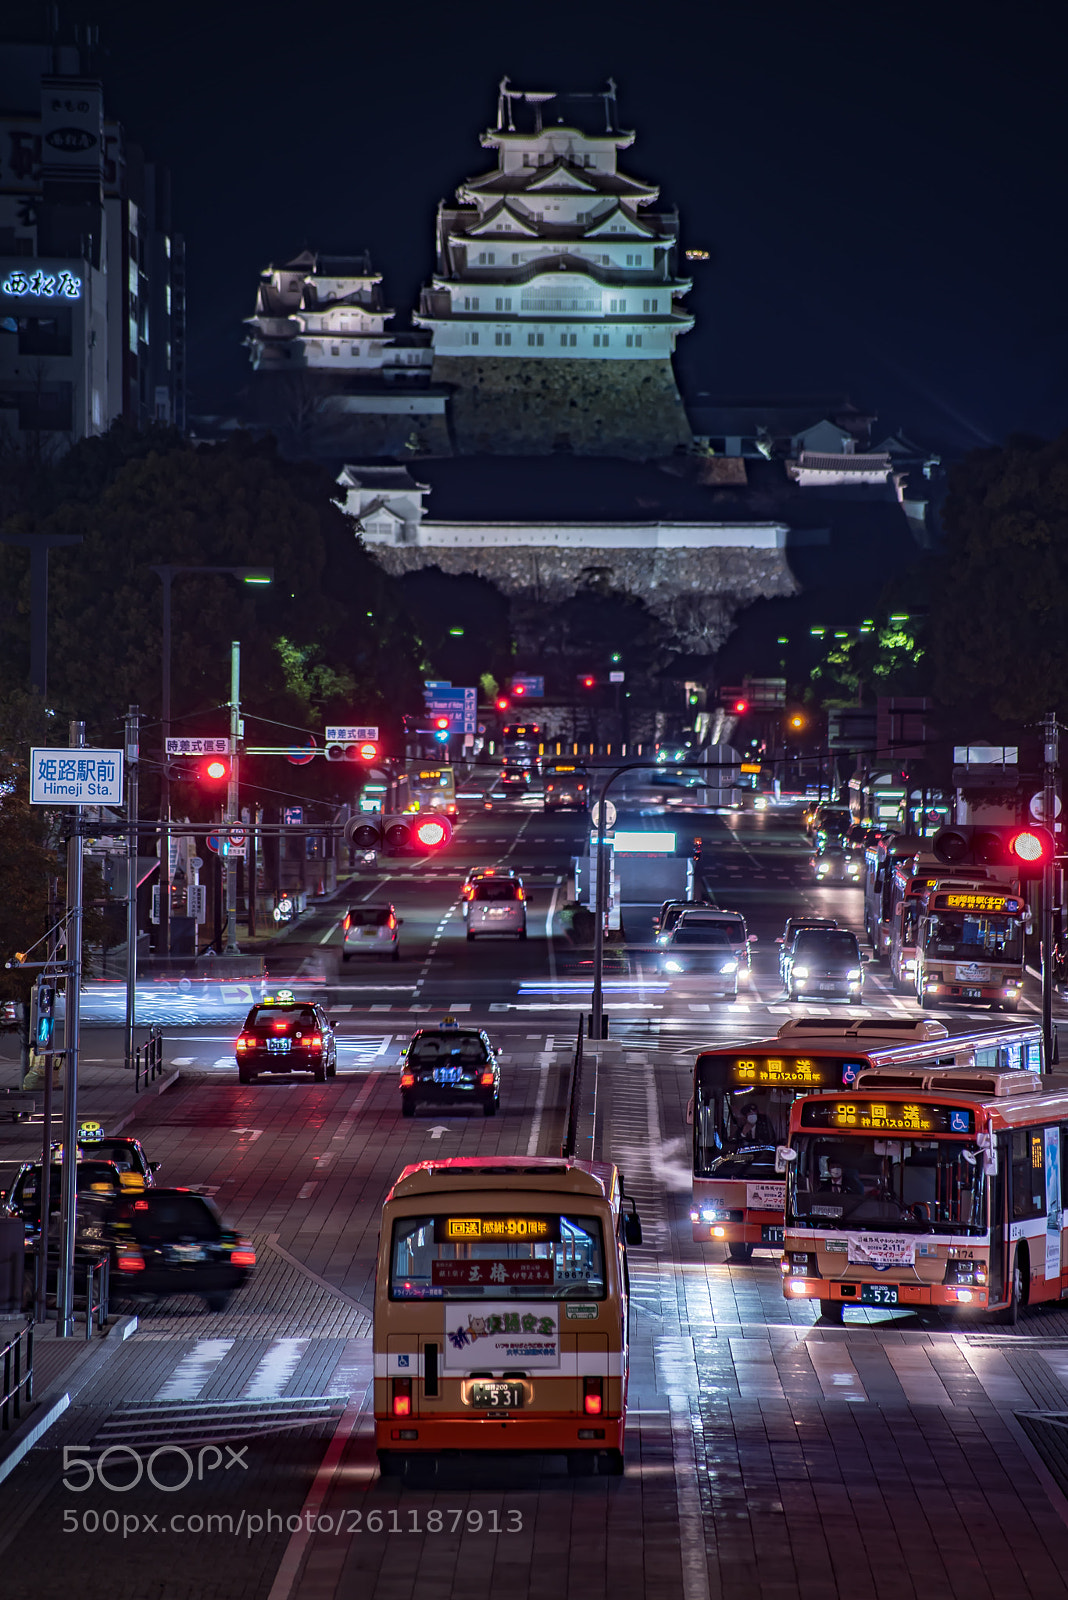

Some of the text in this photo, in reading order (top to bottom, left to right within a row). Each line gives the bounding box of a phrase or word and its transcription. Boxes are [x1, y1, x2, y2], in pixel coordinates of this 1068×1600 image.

[327, 728, 377, 739] 時差式信号
[167, 739, 226, 752] 時差式信号
[38, 759, 116, 782] 姫路駅前
[43, 782, 113, 798] Himeji Sta.
[871, 1103, 920, 1120] 回送
[452, 1222, 478, 1234] 回送
[867, 1250, 912, 1259] ノーマイカーデー
[557, 1271, 591, 1279] 29676
